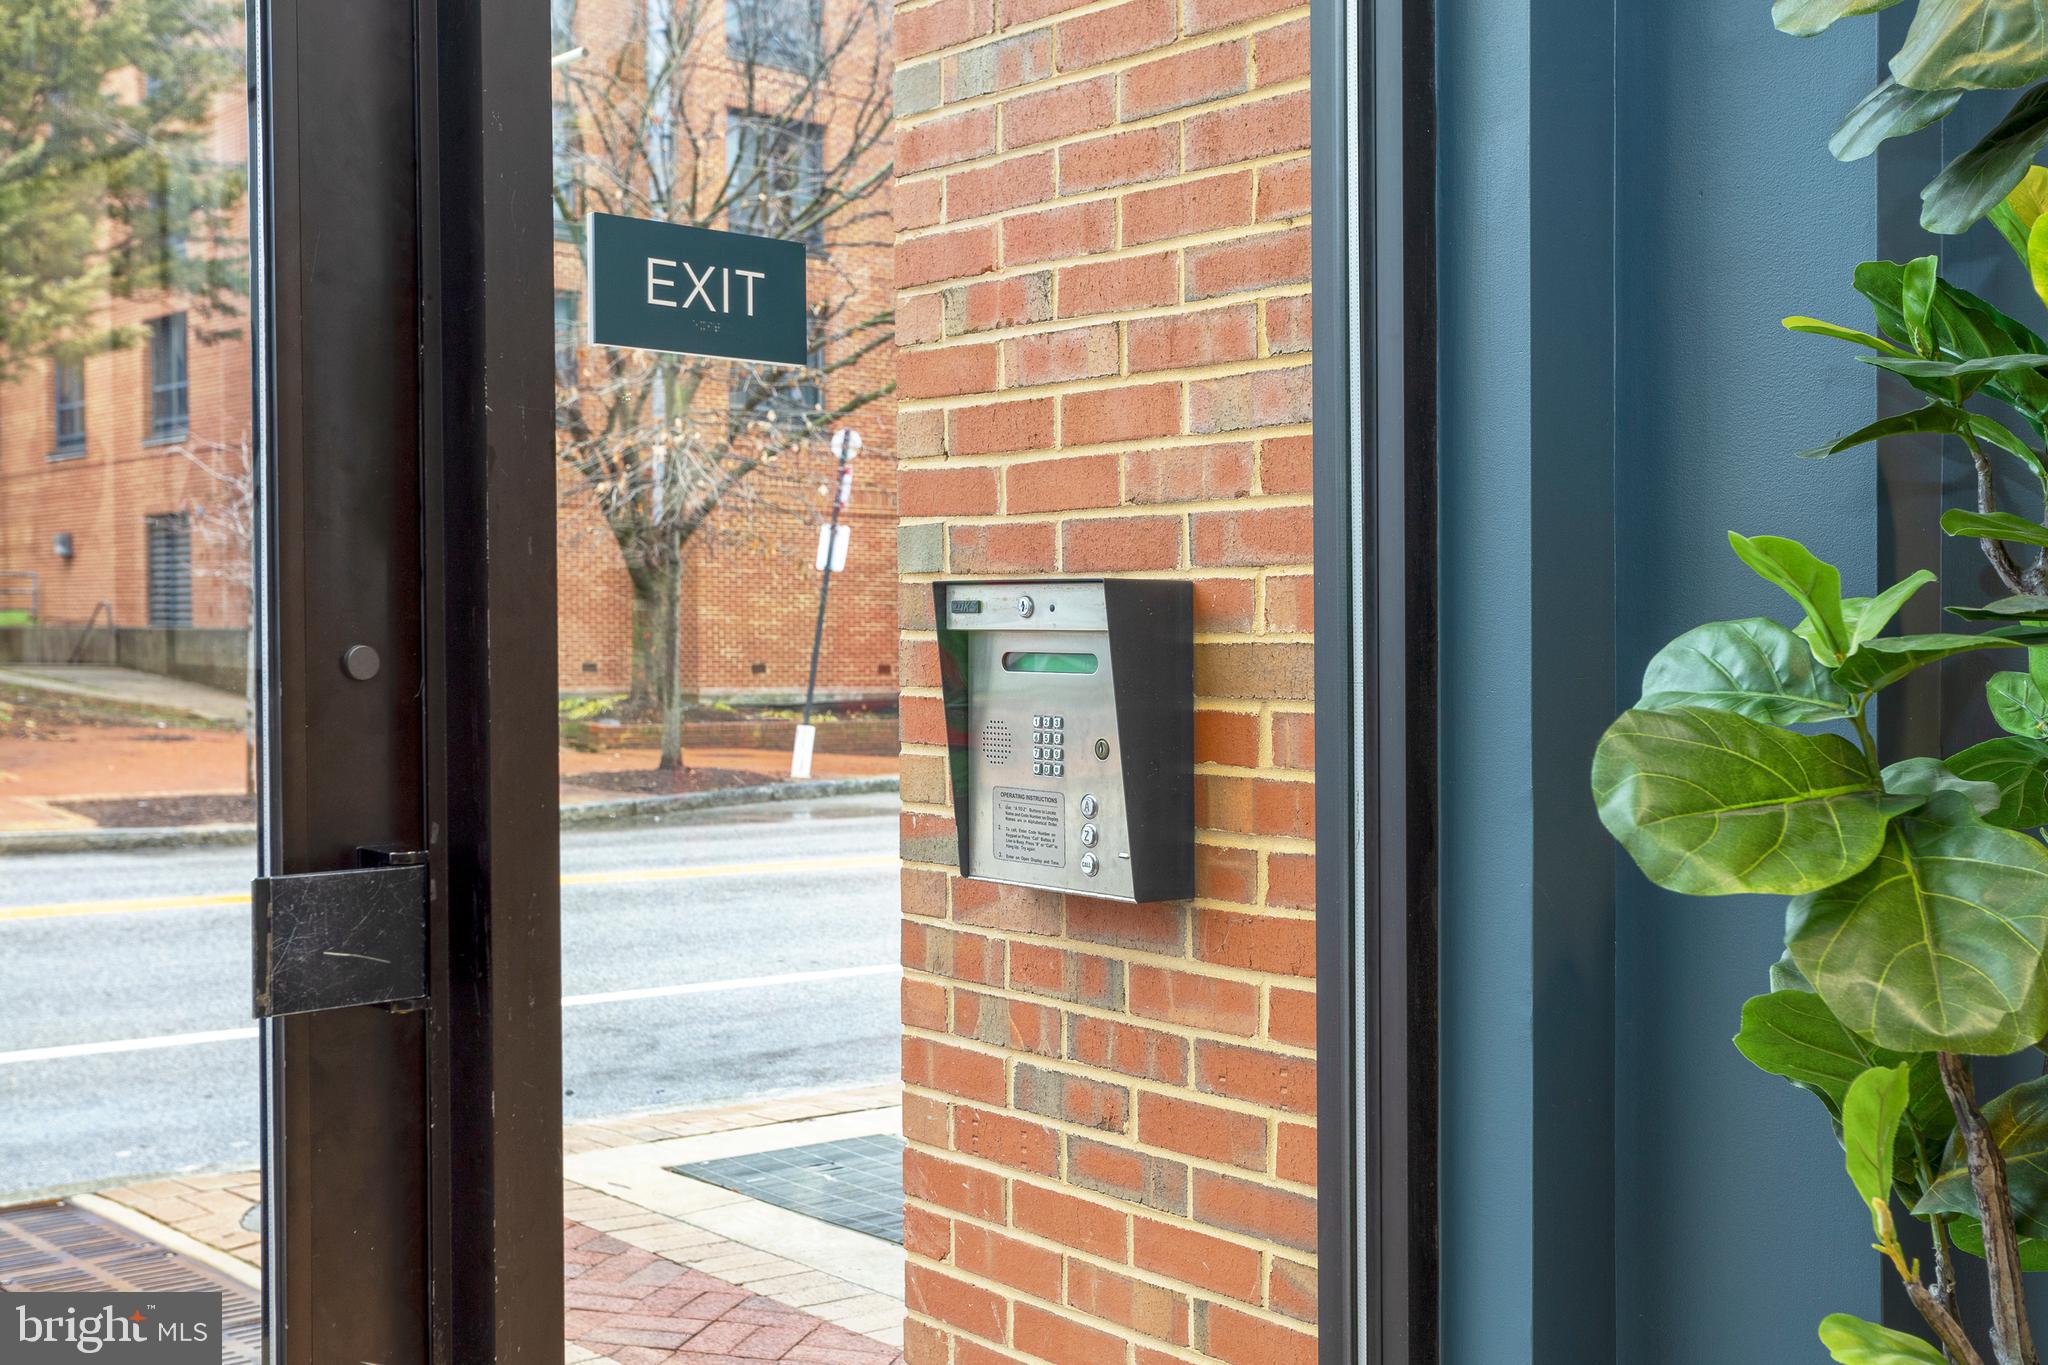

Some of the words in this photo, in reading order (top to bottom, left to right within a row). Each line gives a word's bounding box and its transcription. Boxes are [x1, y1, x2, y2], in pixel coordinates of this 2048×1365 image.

[647, 257, 766, 317] EXIT
[1000, 792, 1025, 800] OPERATING
[1026, 795, 1058, 803] INSTRUCTIONS
[1084, 801, 1090, 812] A
[1084, 830, 1089, 842] Z
